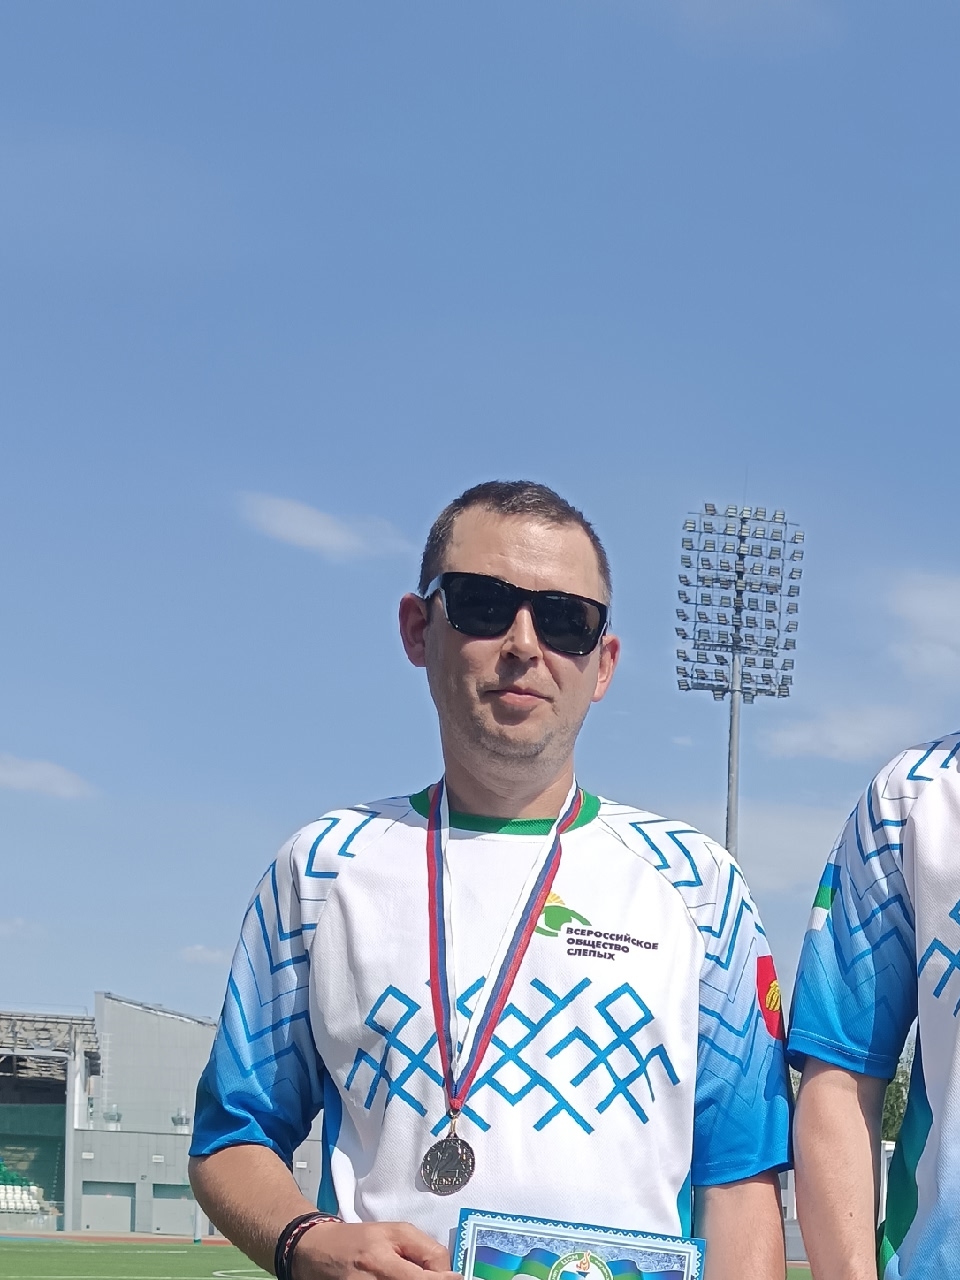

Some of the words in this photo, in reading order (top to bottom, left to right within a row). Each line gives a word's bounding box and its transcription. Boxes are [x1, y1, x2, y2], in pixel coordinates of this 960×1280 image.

[566, 927, 659, 950] ВСЕРОССИЙСКОЕ
[566, 937, 630, 953] ОБЩЕСТВО
[567, 948, 616, 961] СЛЕПЫХ
